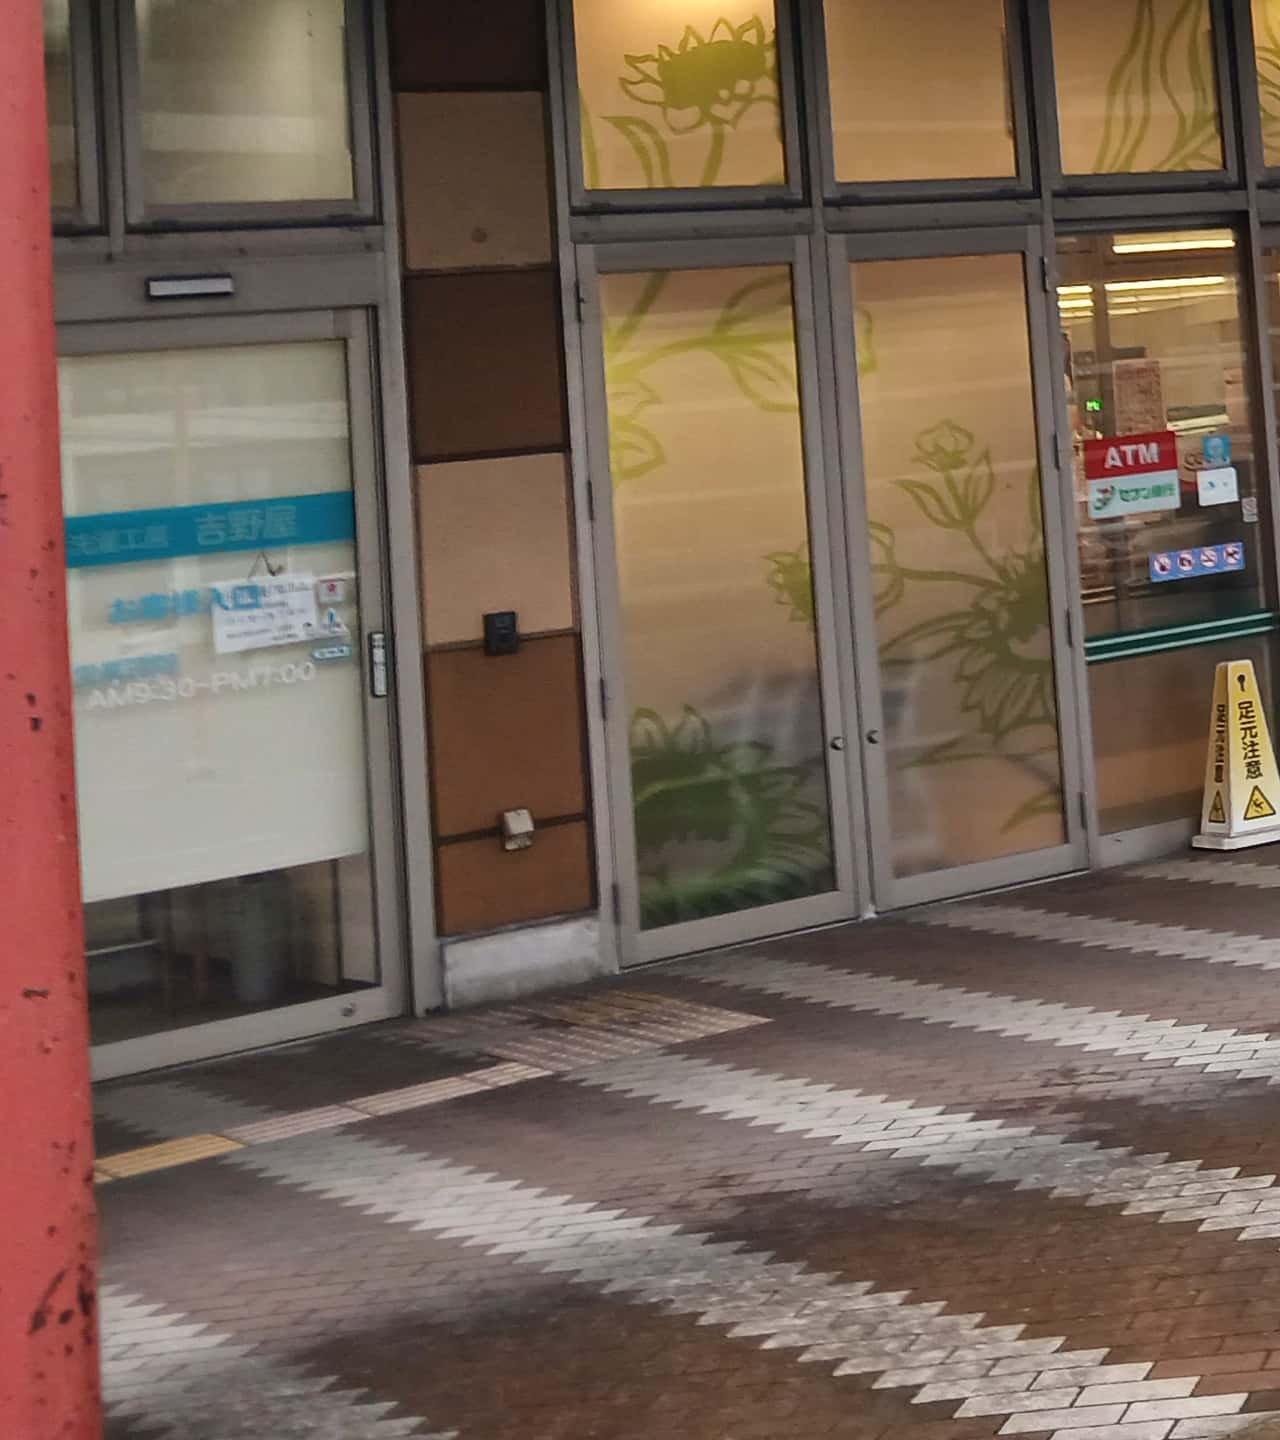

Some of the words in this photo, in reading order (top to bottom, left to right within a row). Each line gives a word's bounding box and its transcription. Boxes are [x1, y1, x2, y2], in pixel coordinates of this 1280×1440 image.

[1104, 442, 1160, 469] ATM
[1238, 700, 1264, 780] 足元注意
